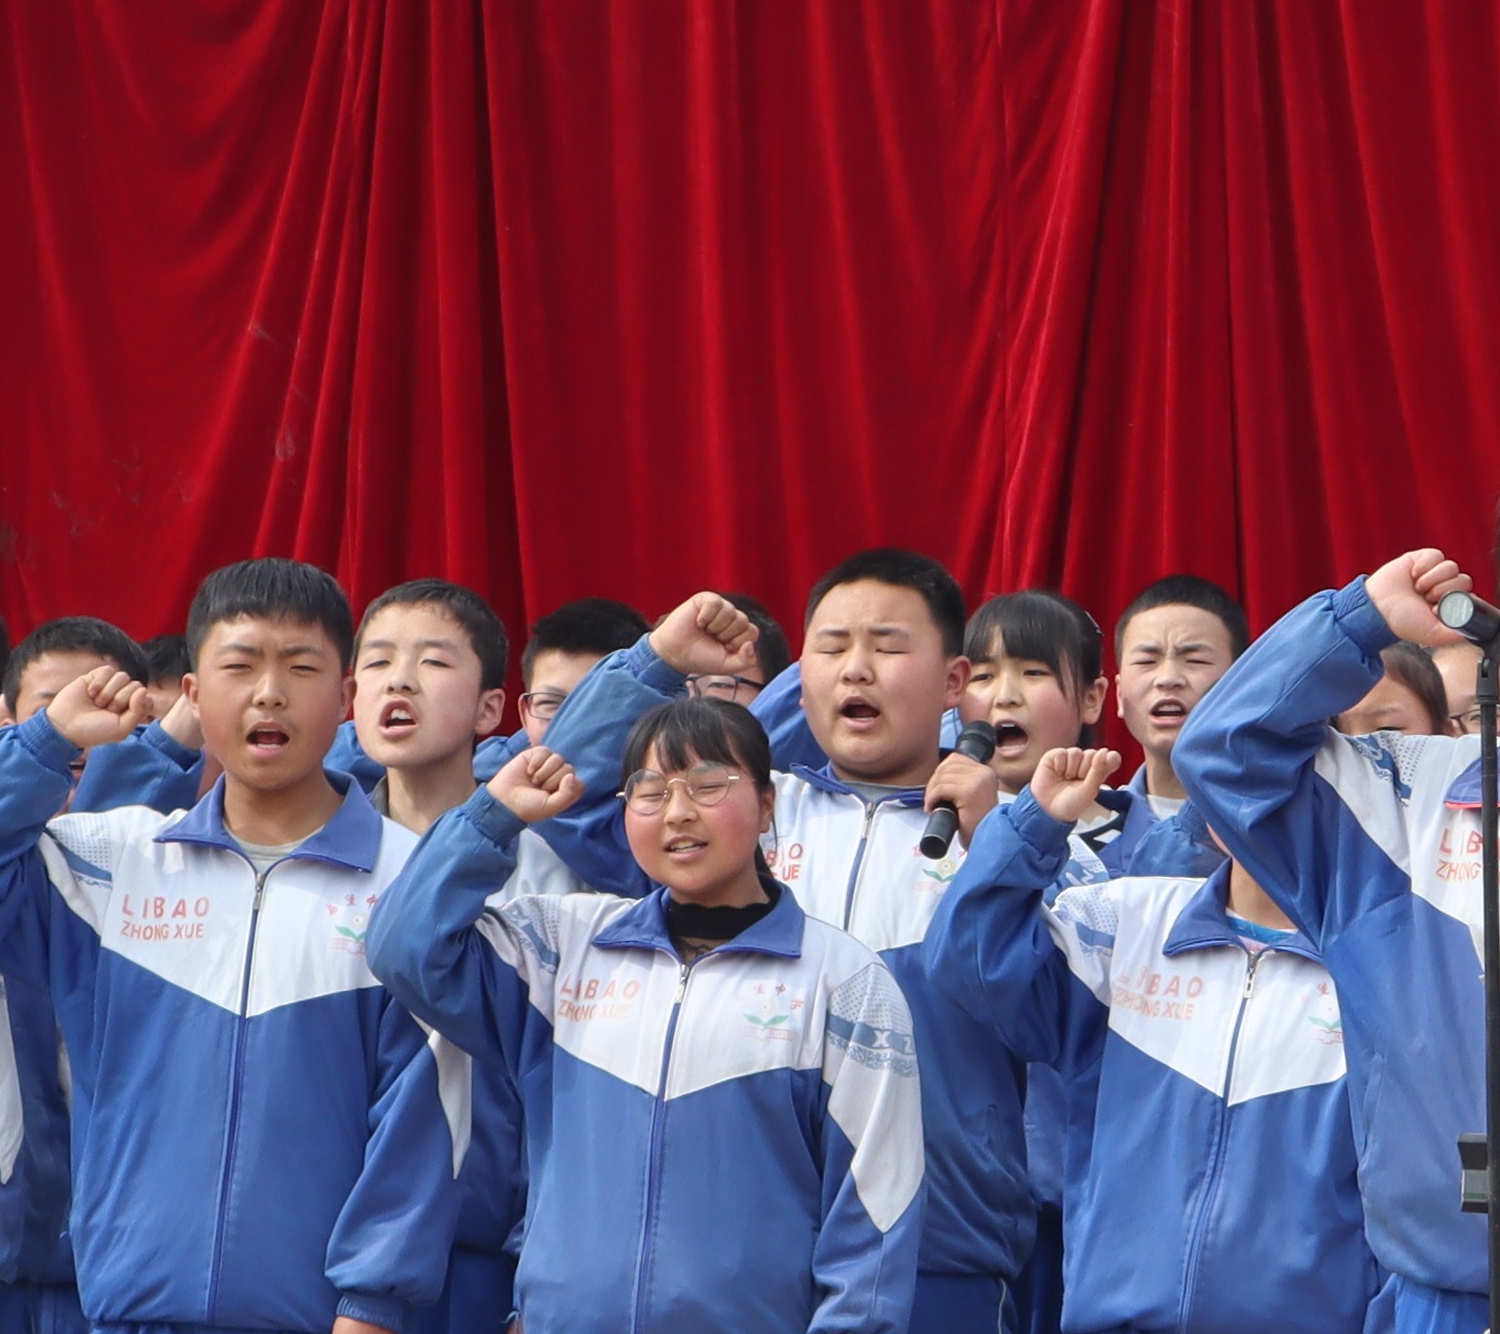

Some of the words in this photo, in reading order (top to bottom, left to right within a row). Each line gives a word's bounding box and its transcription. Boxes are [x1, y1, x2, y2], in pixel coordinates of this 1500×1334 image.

[121, 893, 211, 920] LIBAO
[120, 920, 170, 942] ZHONG
[173, 923, 205, 940] XUE
[560, 973, 642, 1002] LIBAO
